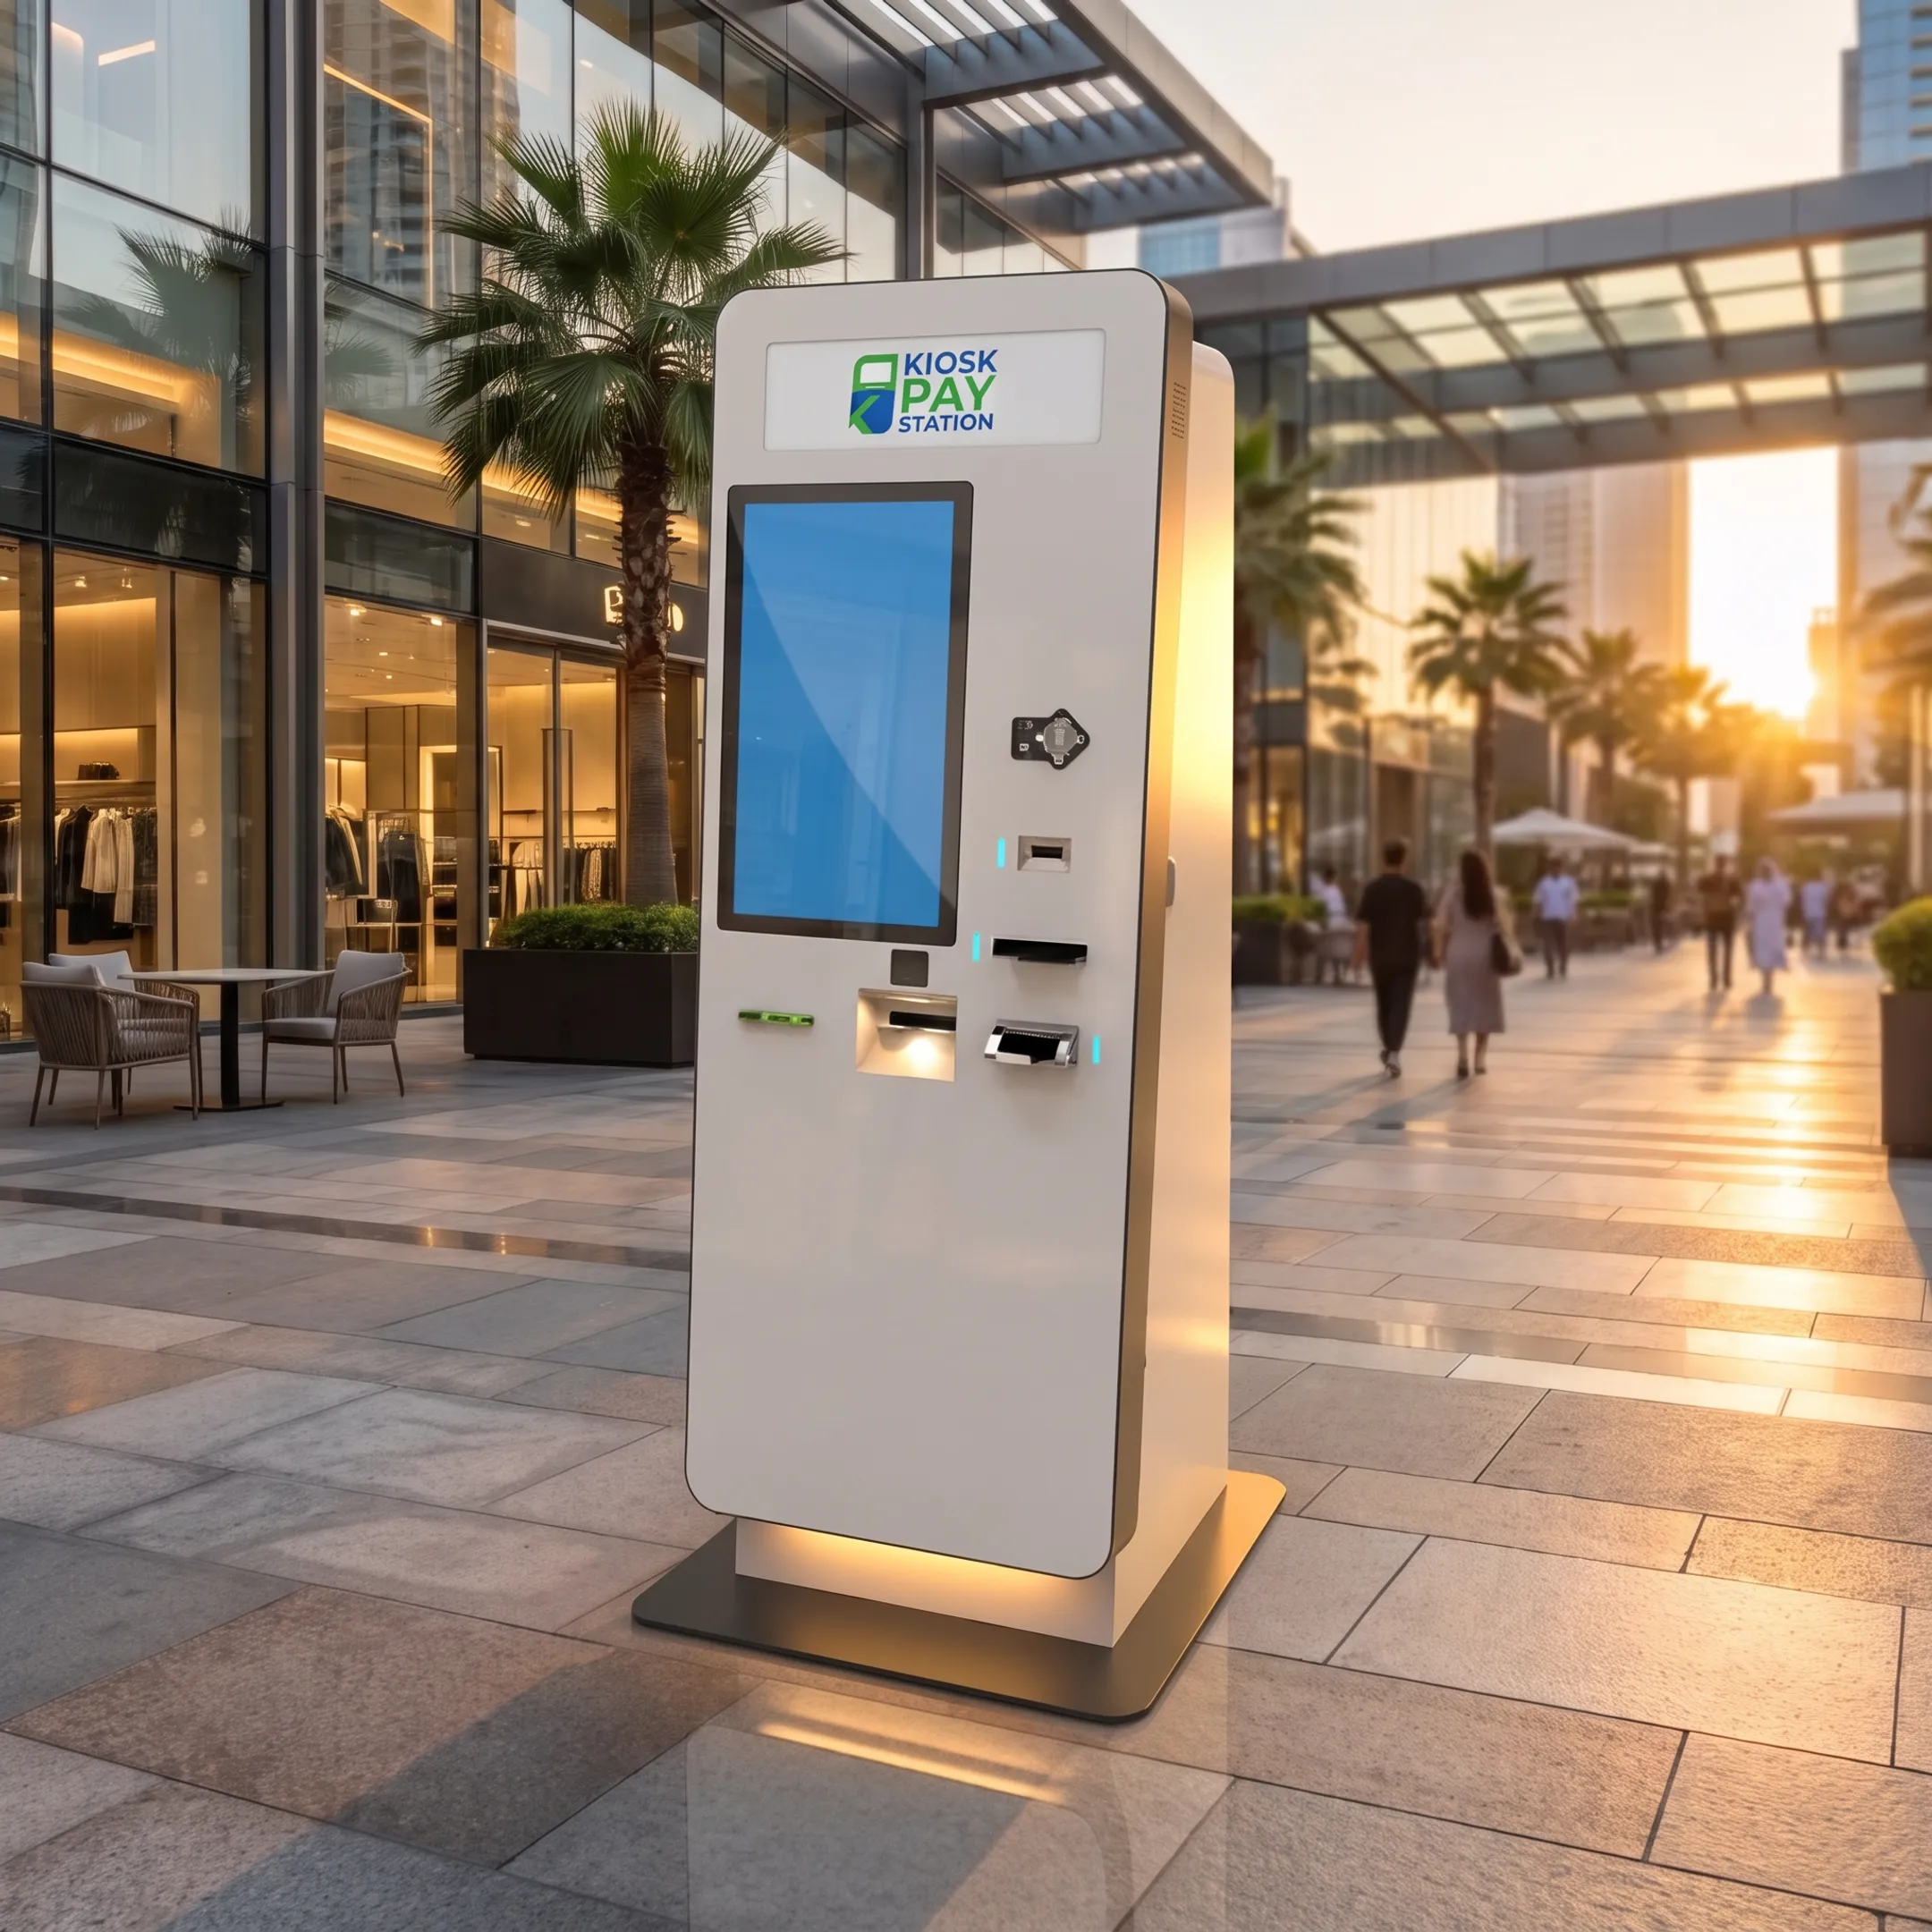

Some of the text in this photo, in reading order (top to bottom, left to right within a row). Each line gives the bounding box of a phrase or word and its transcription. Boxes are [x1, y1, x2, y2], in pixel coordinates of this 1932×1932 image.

[904, 350, 998, 376] KIOSK
[901, 375, 996, 413] PAY
[898, 413, 994, 433] STATION
